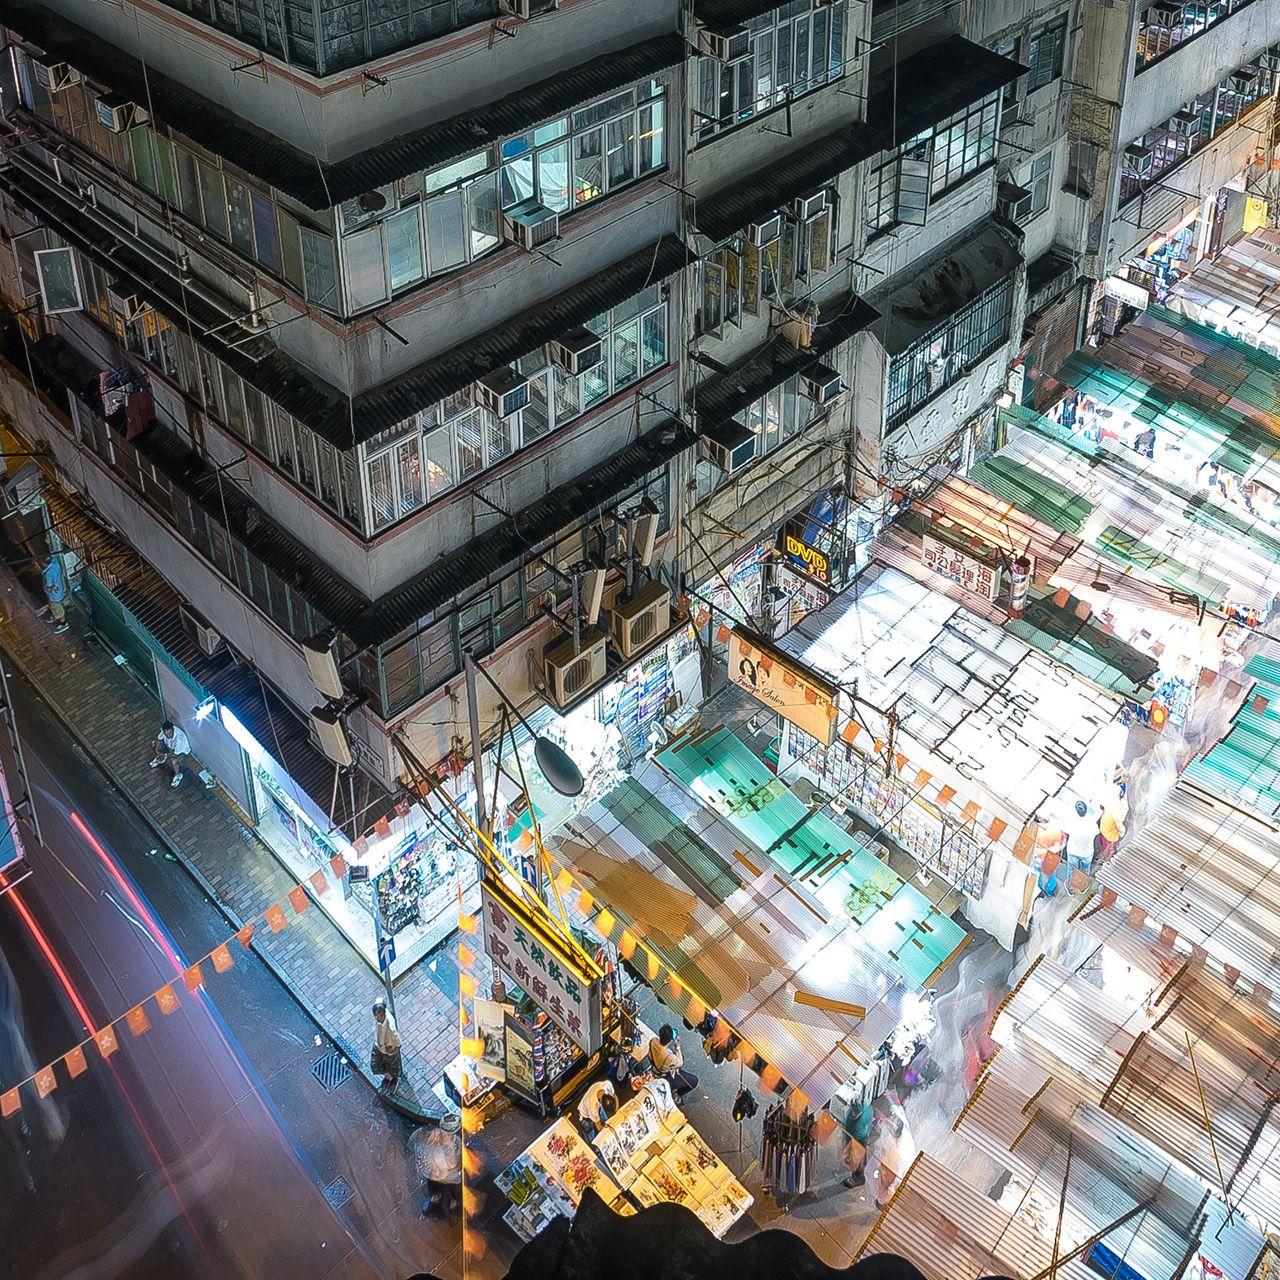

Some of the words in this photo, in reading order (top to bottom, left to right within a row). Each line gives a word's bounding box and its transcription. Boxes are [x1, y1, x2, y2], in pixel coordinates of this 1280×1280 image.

[786, 535, 827, 572] DVD
[807, 563, 827, 581] $10
[733, 675, 760, 696] Image
[761, 687, 786, 706] Salon
[513, 925, 583, 1006] 天然飲品
